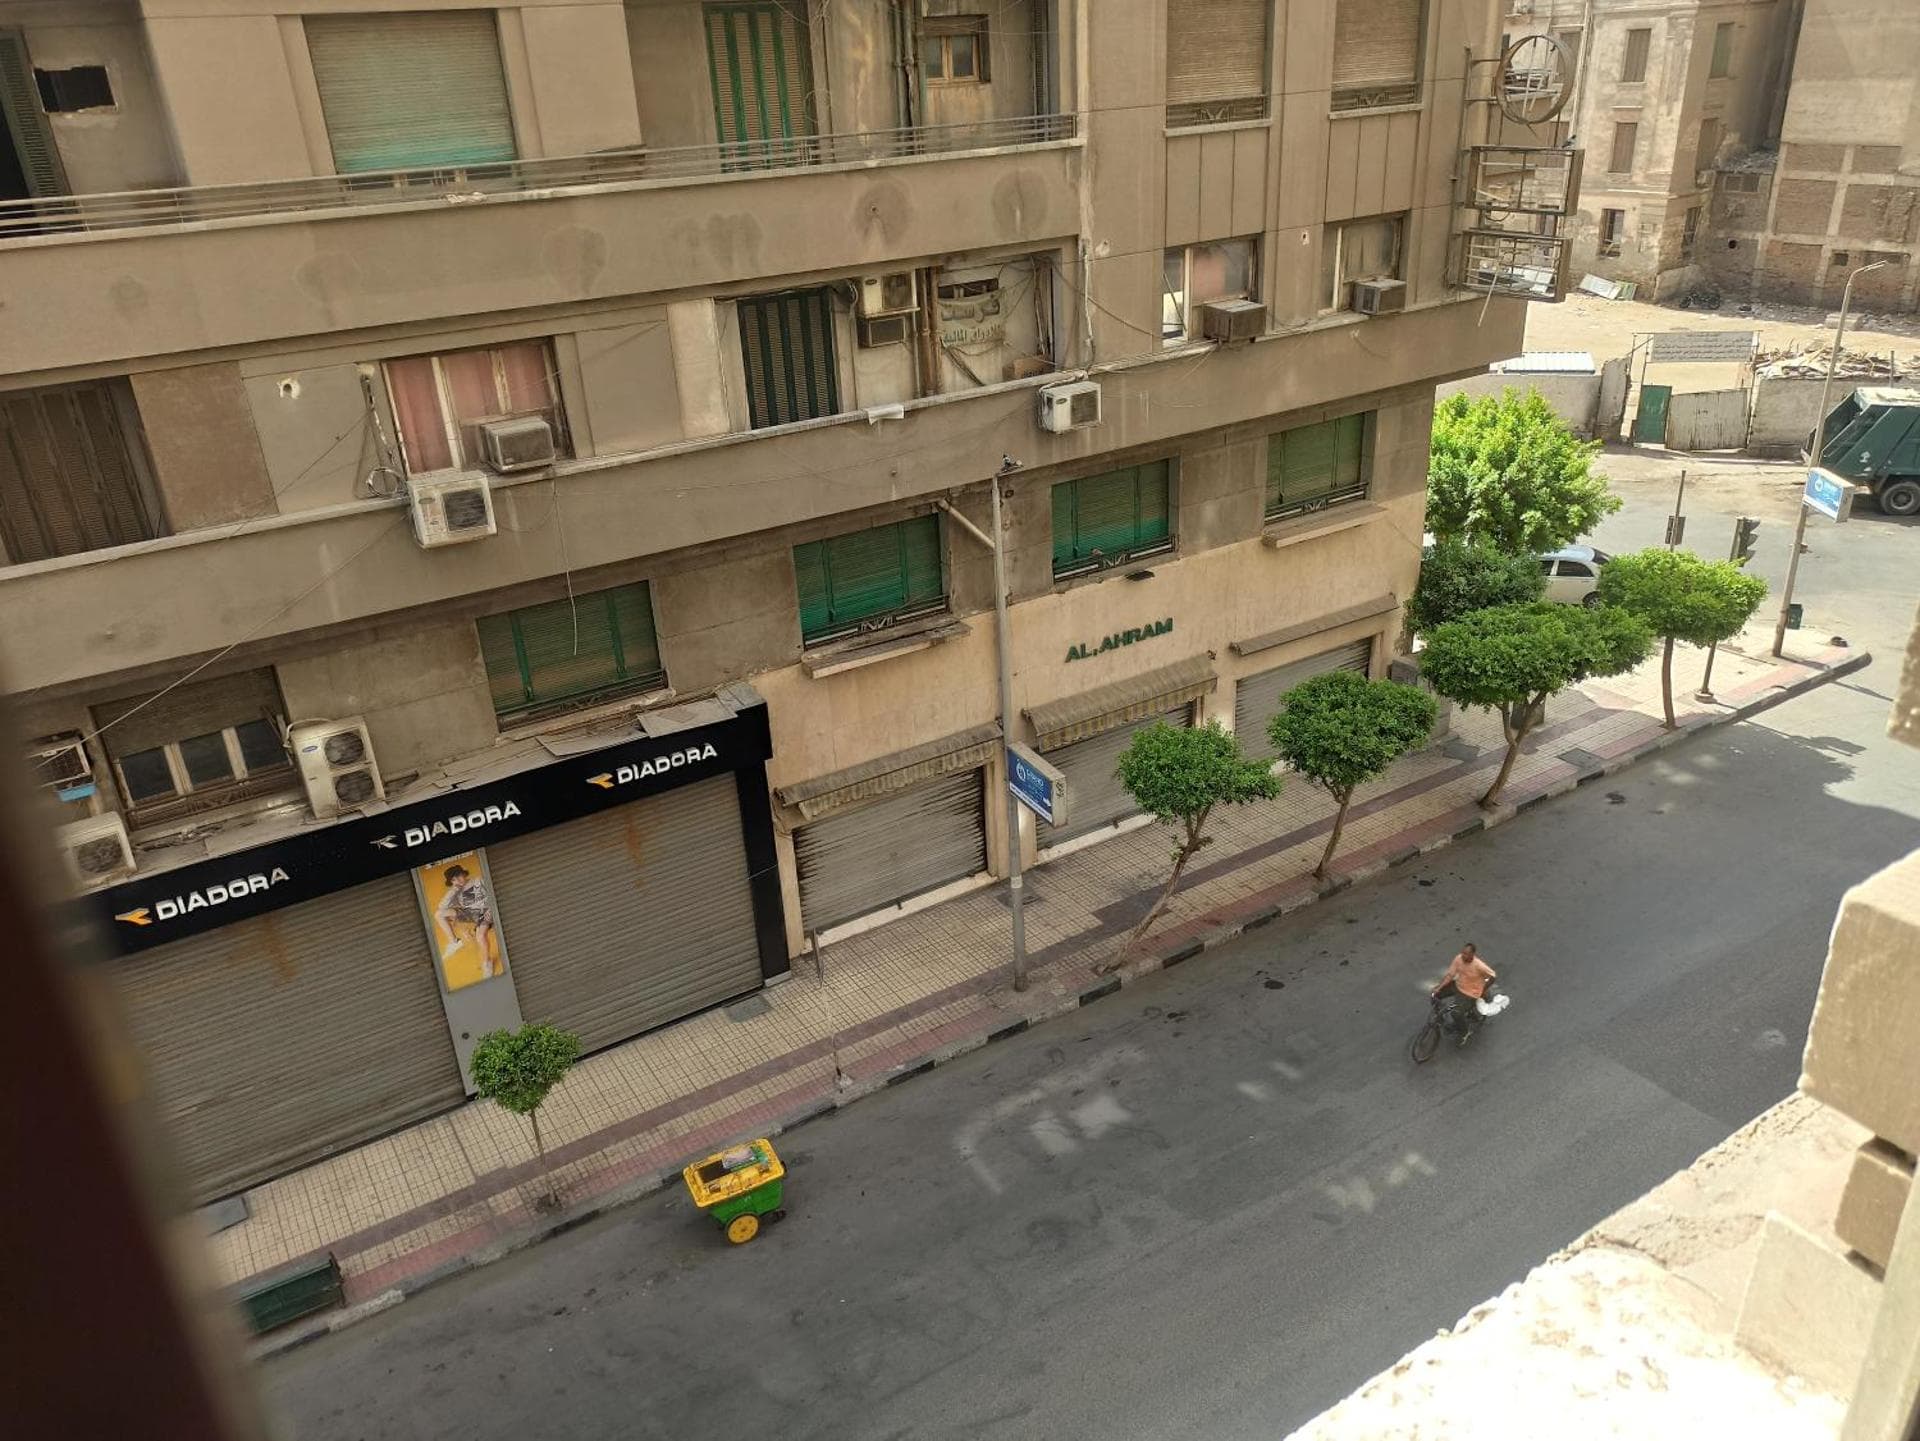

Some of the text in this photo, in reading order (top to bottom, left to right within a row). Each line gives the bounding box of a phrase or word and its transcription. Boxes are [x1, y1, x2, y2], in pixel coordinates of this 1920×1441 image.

[616, 742, 718, 784] DIADORA
[404, 799, 521, 848] DIADORA
[155, 866, 290, 921] DIADORA
